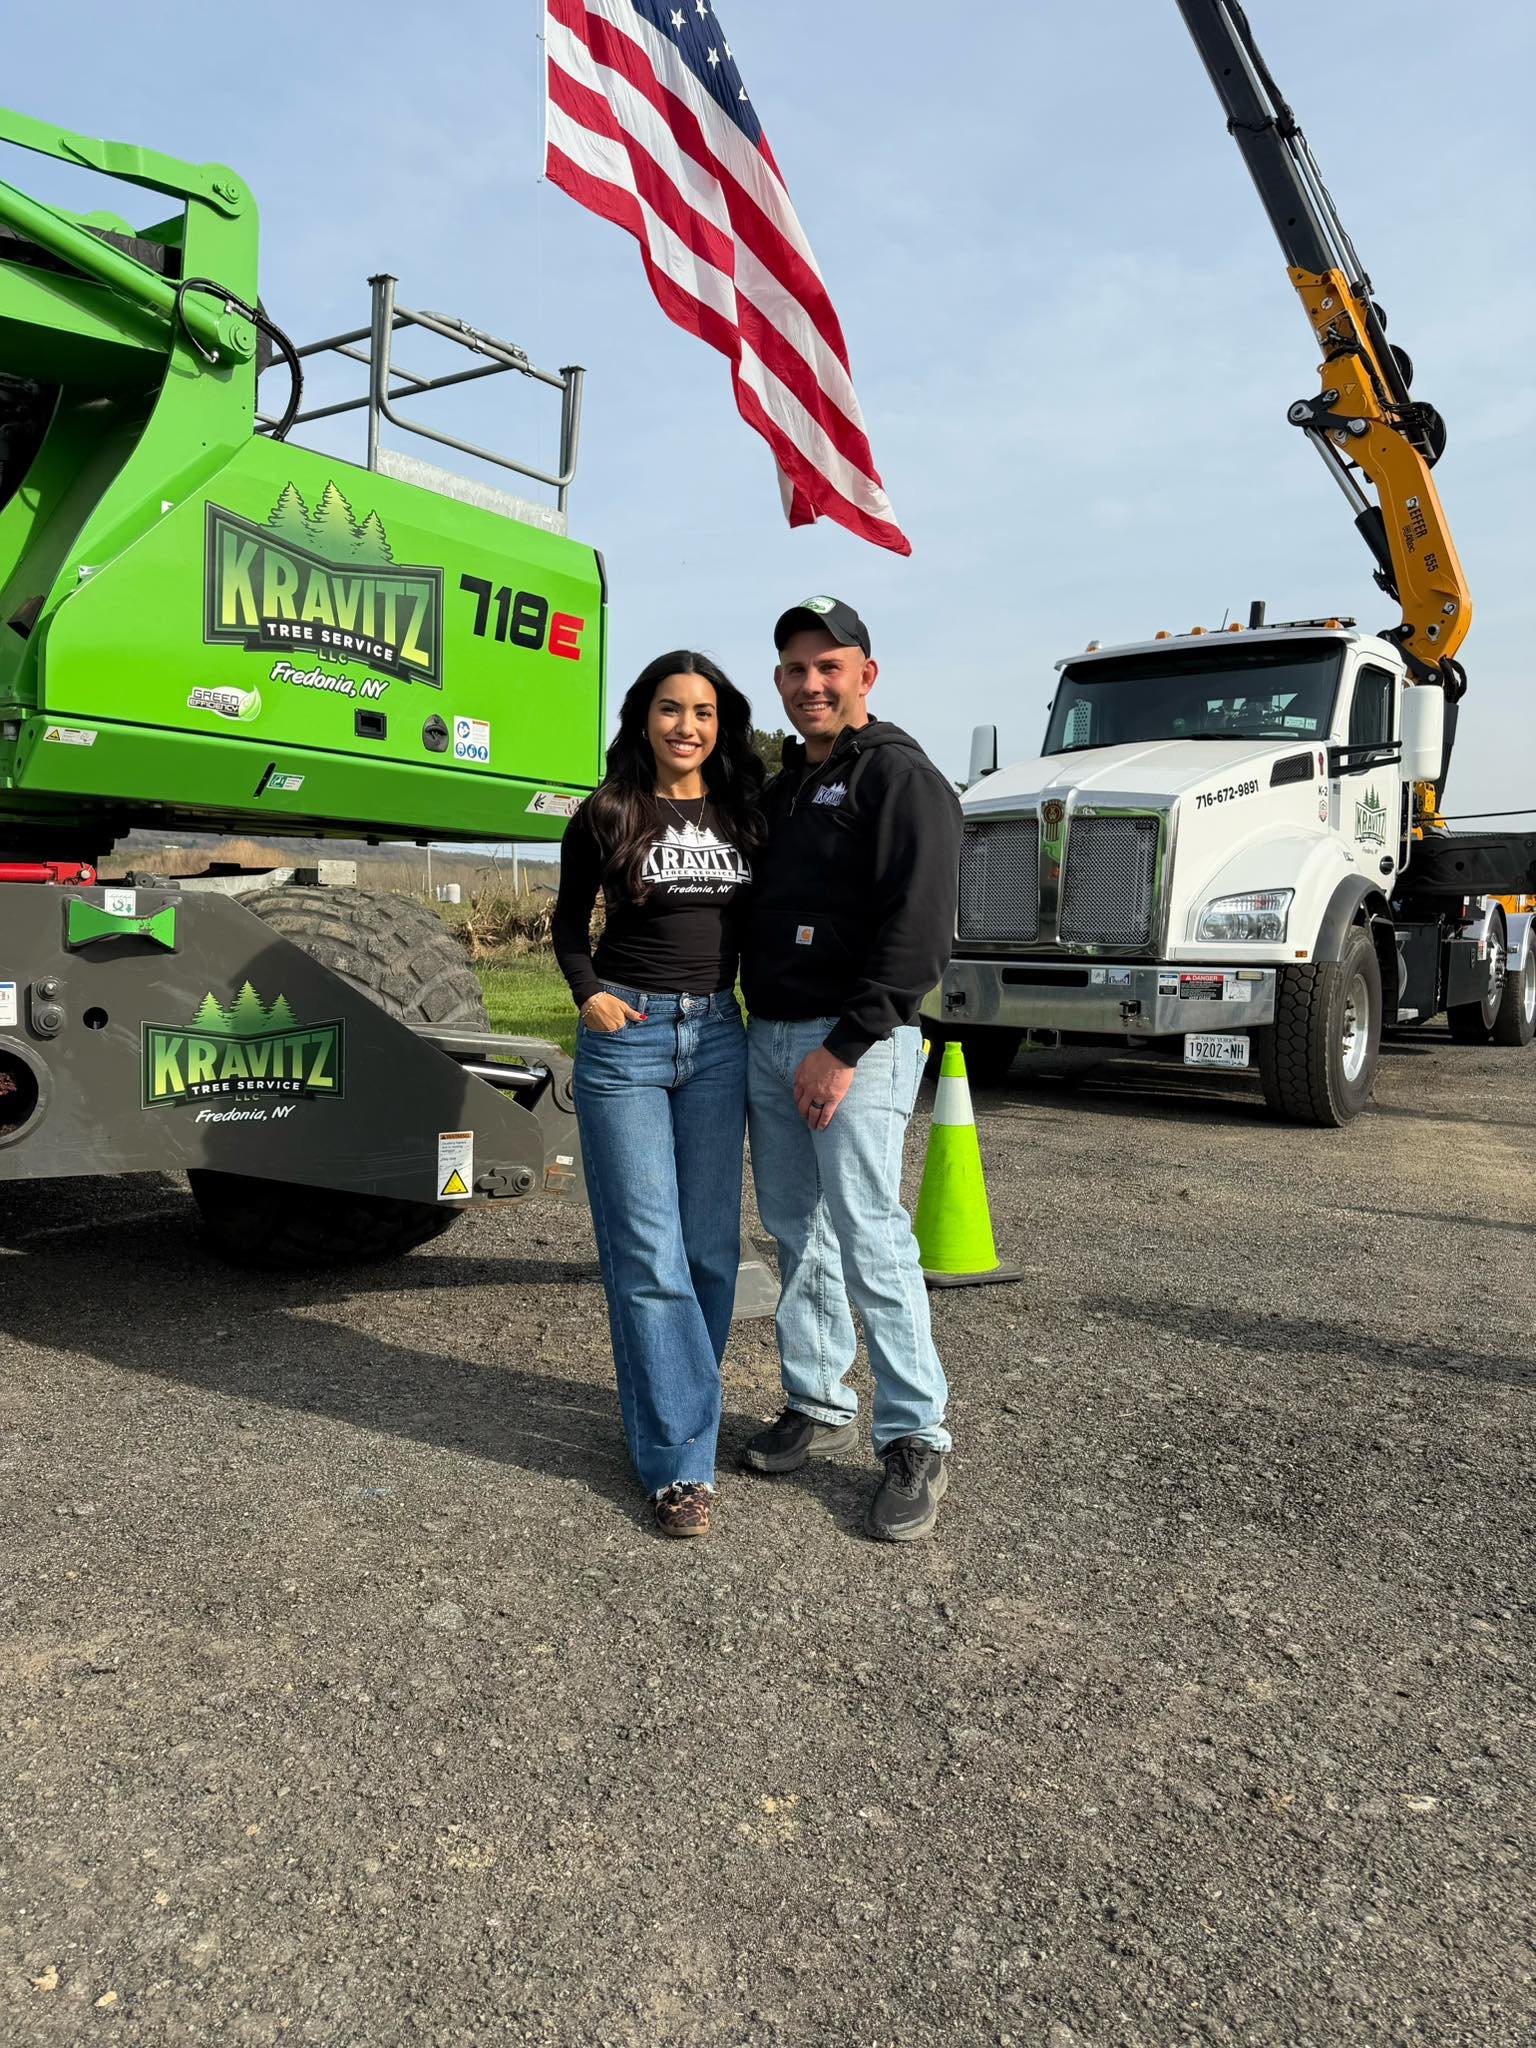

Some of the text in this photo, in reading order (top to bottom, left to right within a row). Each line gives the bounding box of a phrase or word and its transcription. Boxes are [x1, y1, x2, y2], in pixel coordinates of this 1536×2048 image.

[1408, 508, 1428, 538] EFFER
[1424, 553, 1439, 573] 655
[221, 529, 430, 668] KRAVITZ
[459, 573, 585, 662] 718E
[267, 623, 394, 662] TREE SERVICE
[318, 648, 349, 664] LLC
[270, 661, 390, 699] Fredonia, NY
[193, 689, 240, 705] GREEN
[1195, 779, 1260, 810] 716-672-9891
[1356, 806, 1386, 840] KRAVITZ
[664, 869, 734, 877] TREE SERVICE
[667, 883, 733, 895] Fredonia, NY
[154, 1031, 335, 1096] KRAVITZ
[191, 1080, 301, 1095] TREE SERVICE
[234, 1092, 260, 1102] LLC
[194, 1104, 296, 1124] Fredonia, NY
